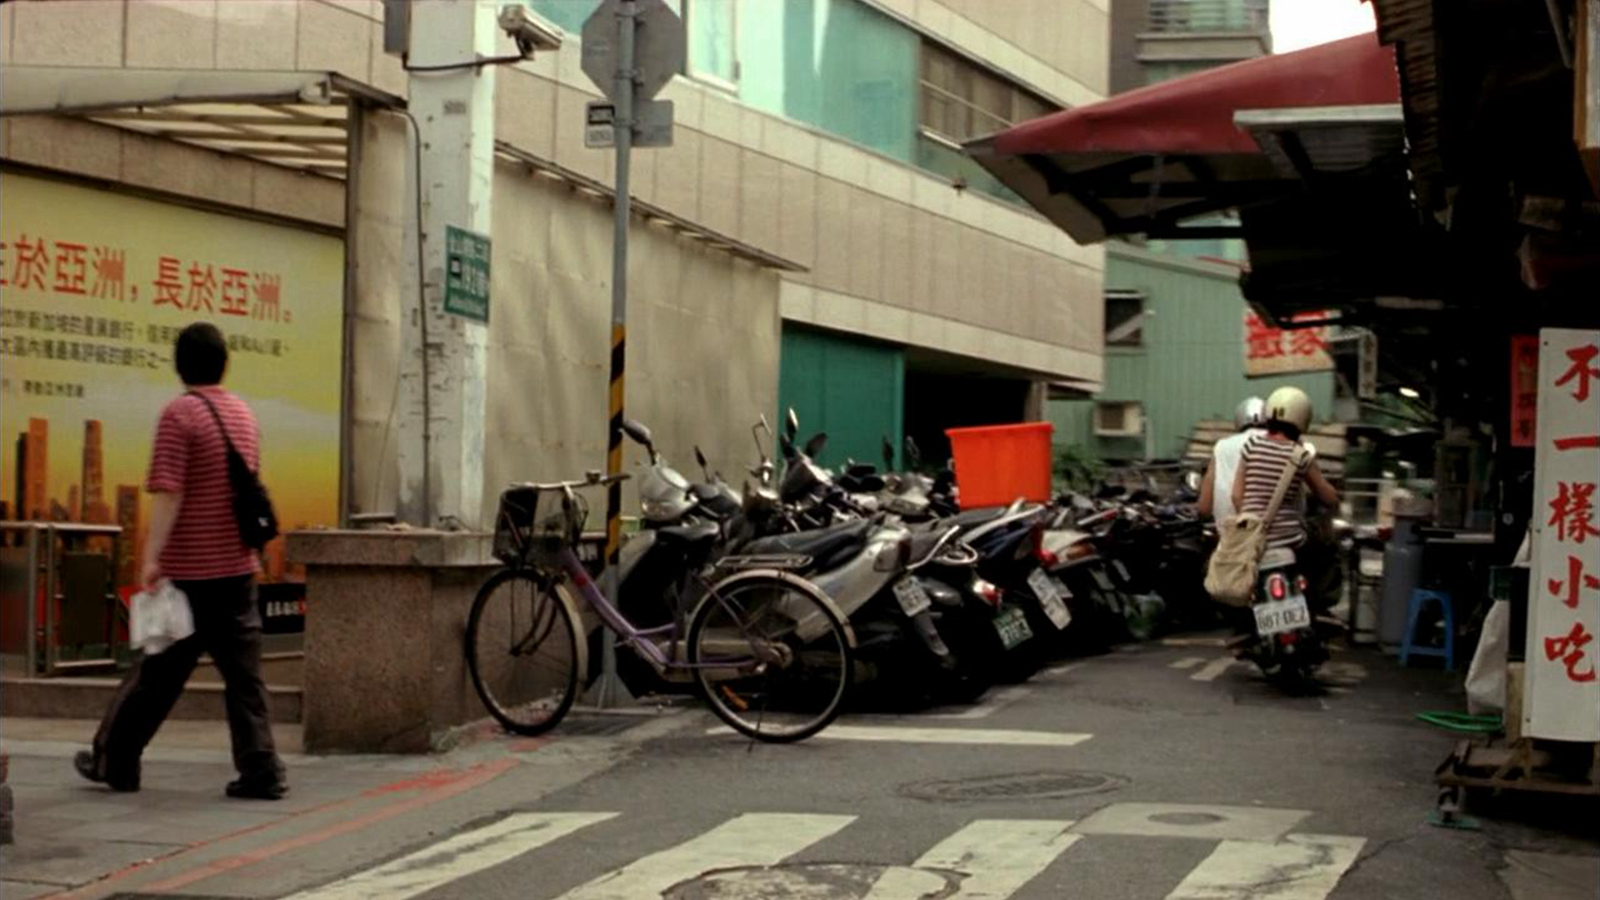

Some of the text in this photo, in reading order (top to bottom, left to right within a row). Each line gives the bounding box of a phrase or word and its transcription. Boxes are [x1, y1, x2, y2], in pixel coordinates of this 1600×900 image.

[0, 233, 292, 323] 於亞洲，長於亞洲。
